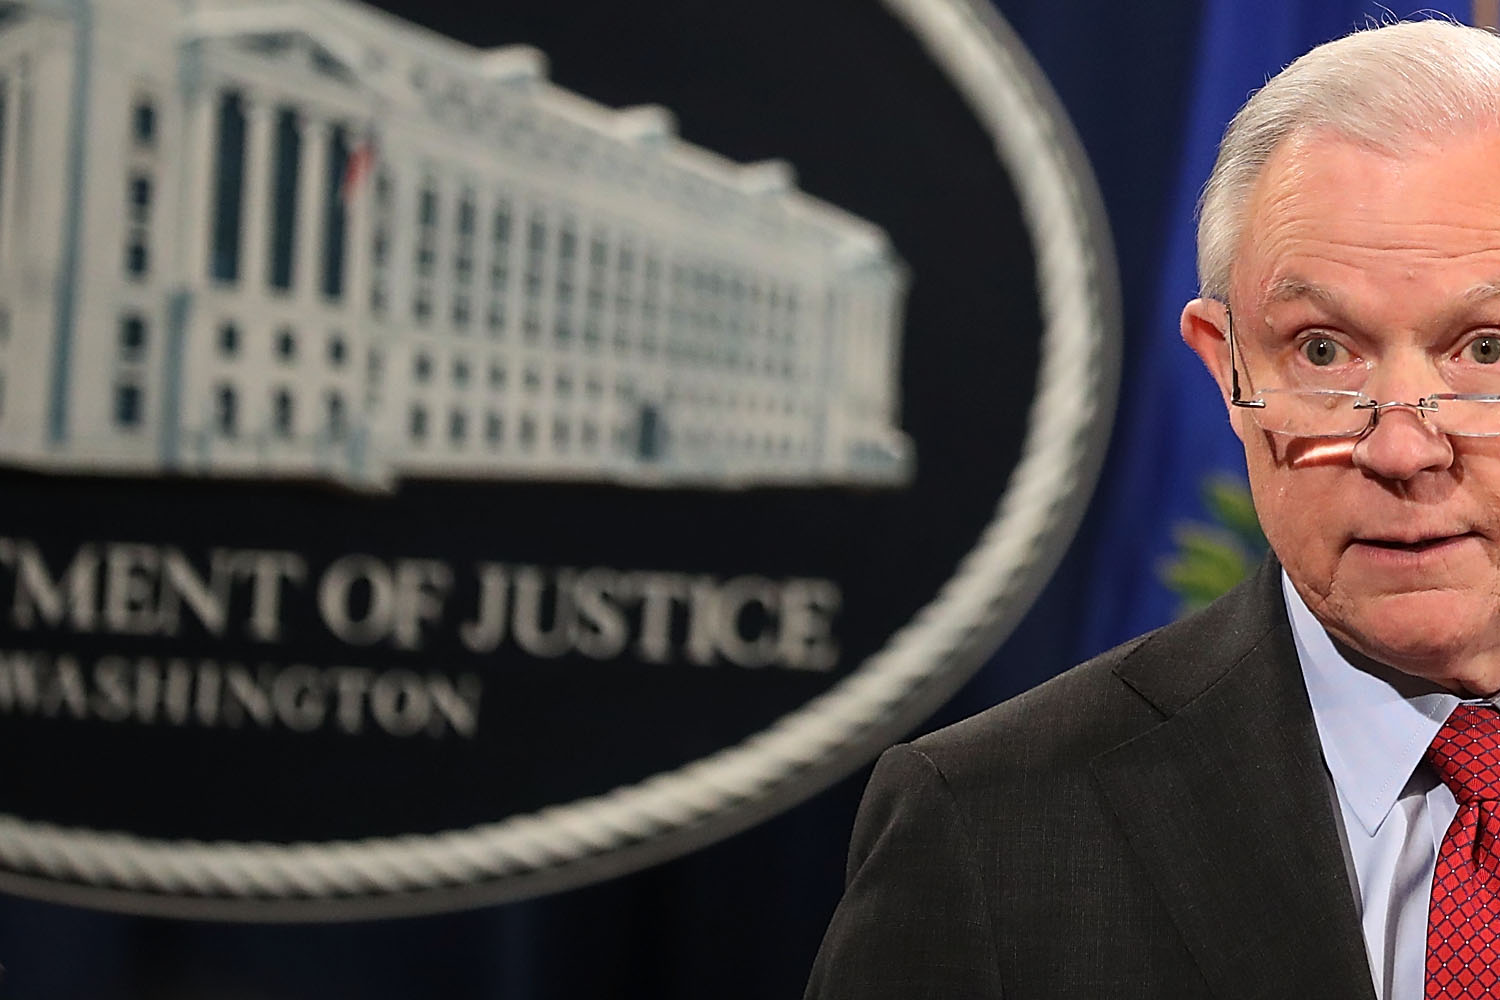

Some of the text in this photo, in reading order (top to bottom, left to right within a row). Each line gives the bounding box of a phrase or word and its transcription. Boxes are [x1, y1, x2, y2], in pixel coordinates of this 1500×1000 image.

[0, 537, 842, 672] MENT OF JUSTICE
